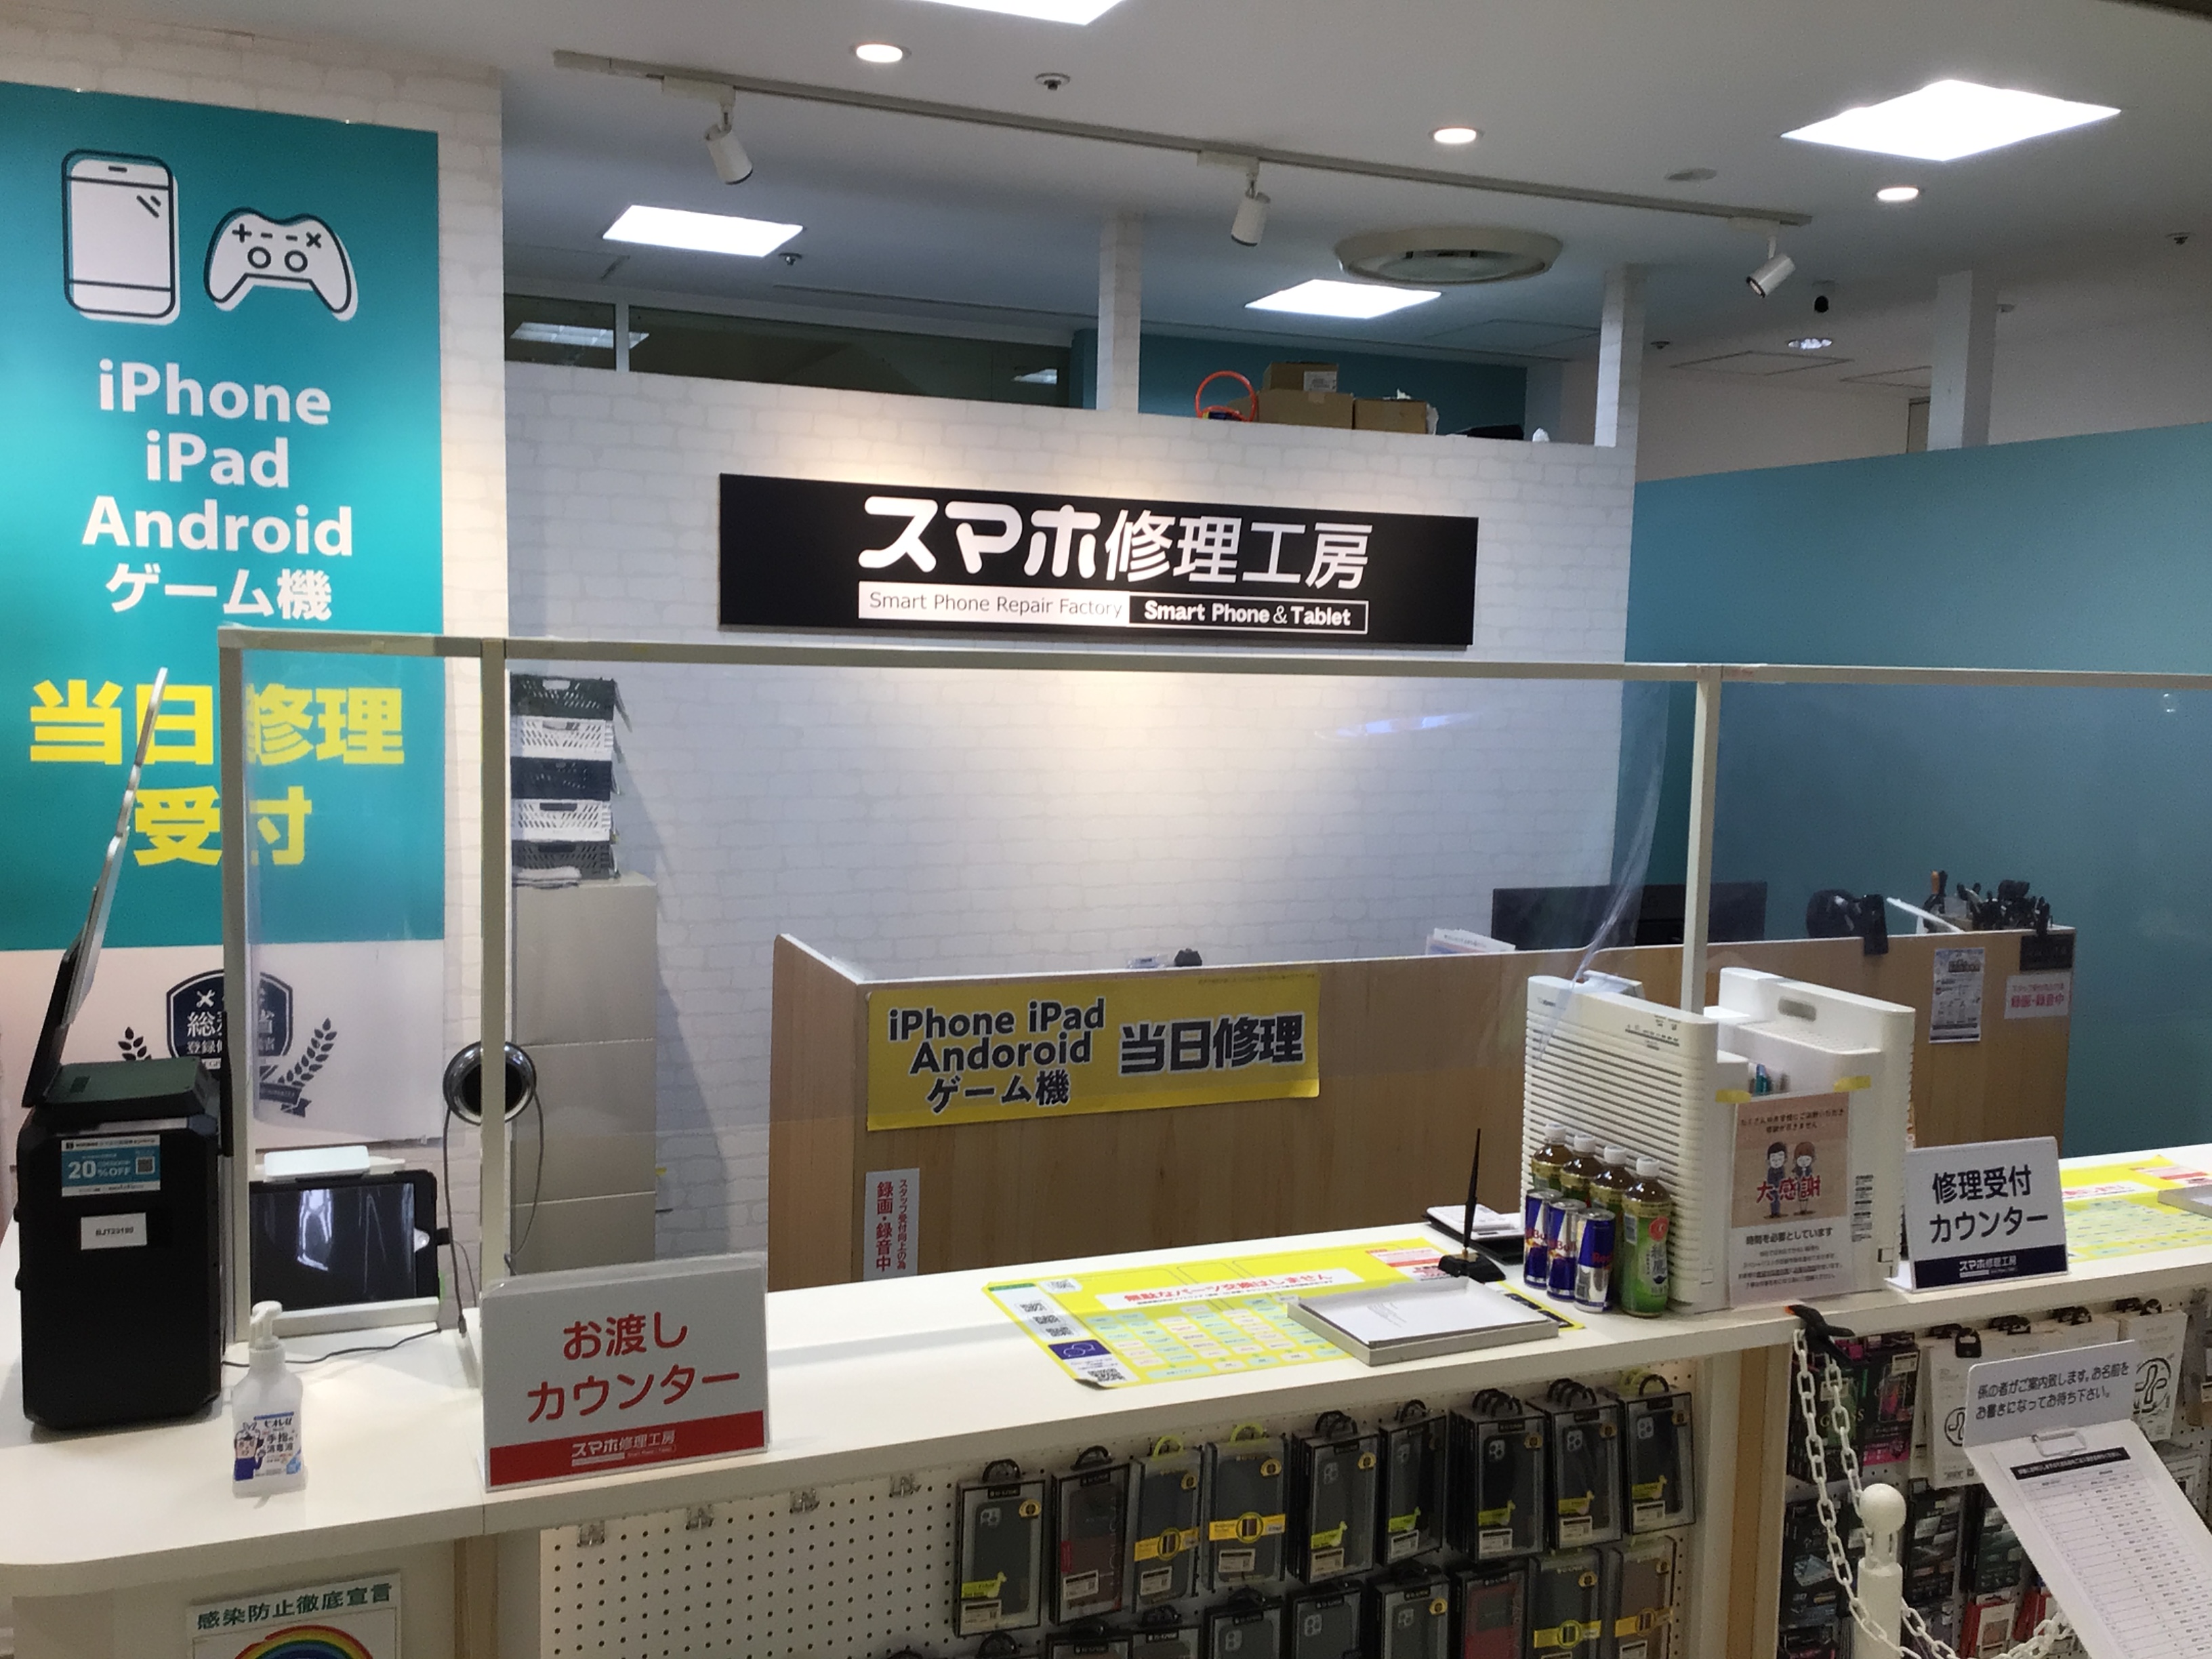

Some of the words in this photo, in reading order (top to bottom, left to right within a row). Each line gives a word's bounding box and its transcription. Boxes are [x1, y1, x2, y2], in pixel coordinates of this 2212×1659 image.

[99, 359, 331, 425] iPhone
[146, 430, 289, 488] iPad
[81, 495, 352, 556] Android
[858, 495, 1373, 590] スマホ修理工房
[105, 563, 332, 621] ゲーム機
[869, 592, 926, 610] Smart
[934, 594, 989, 612] Phone
[997, 596, 1053, 617] Repair
[1060, 598, 1122, 619] Factory
[1144, 600, 1206, 621] Smart
[30, 680, 404, 765] 当日修理
[134, 785, 312, 866] 受付
[889, 1008, 1015, 1042] iPhone
[1028, 998, 1105, 1033] iPad
[1120, 1013, 1303, 1075] 当日修理
[910, 1031, 1091, 1074] Andoroid
[926, 1069, 1069, 1113] ゲーム機
[1756, 1174, 1822, 1204] 大感謝
[1932, 1164, 2032, 1204] 修理受付
[1746, 1227, 1832, 1245] 時間を必要としています
[1929, 1206, 2048, 1244] カウンター
[563, 1311, 687, 1360] お渡し
[527, 1364, 740, 1422] カウンター
[572, 1430, 675, 1457] スマホ修理工房
[198, 1582, 392, 1630] 感染防止徹底宣言
